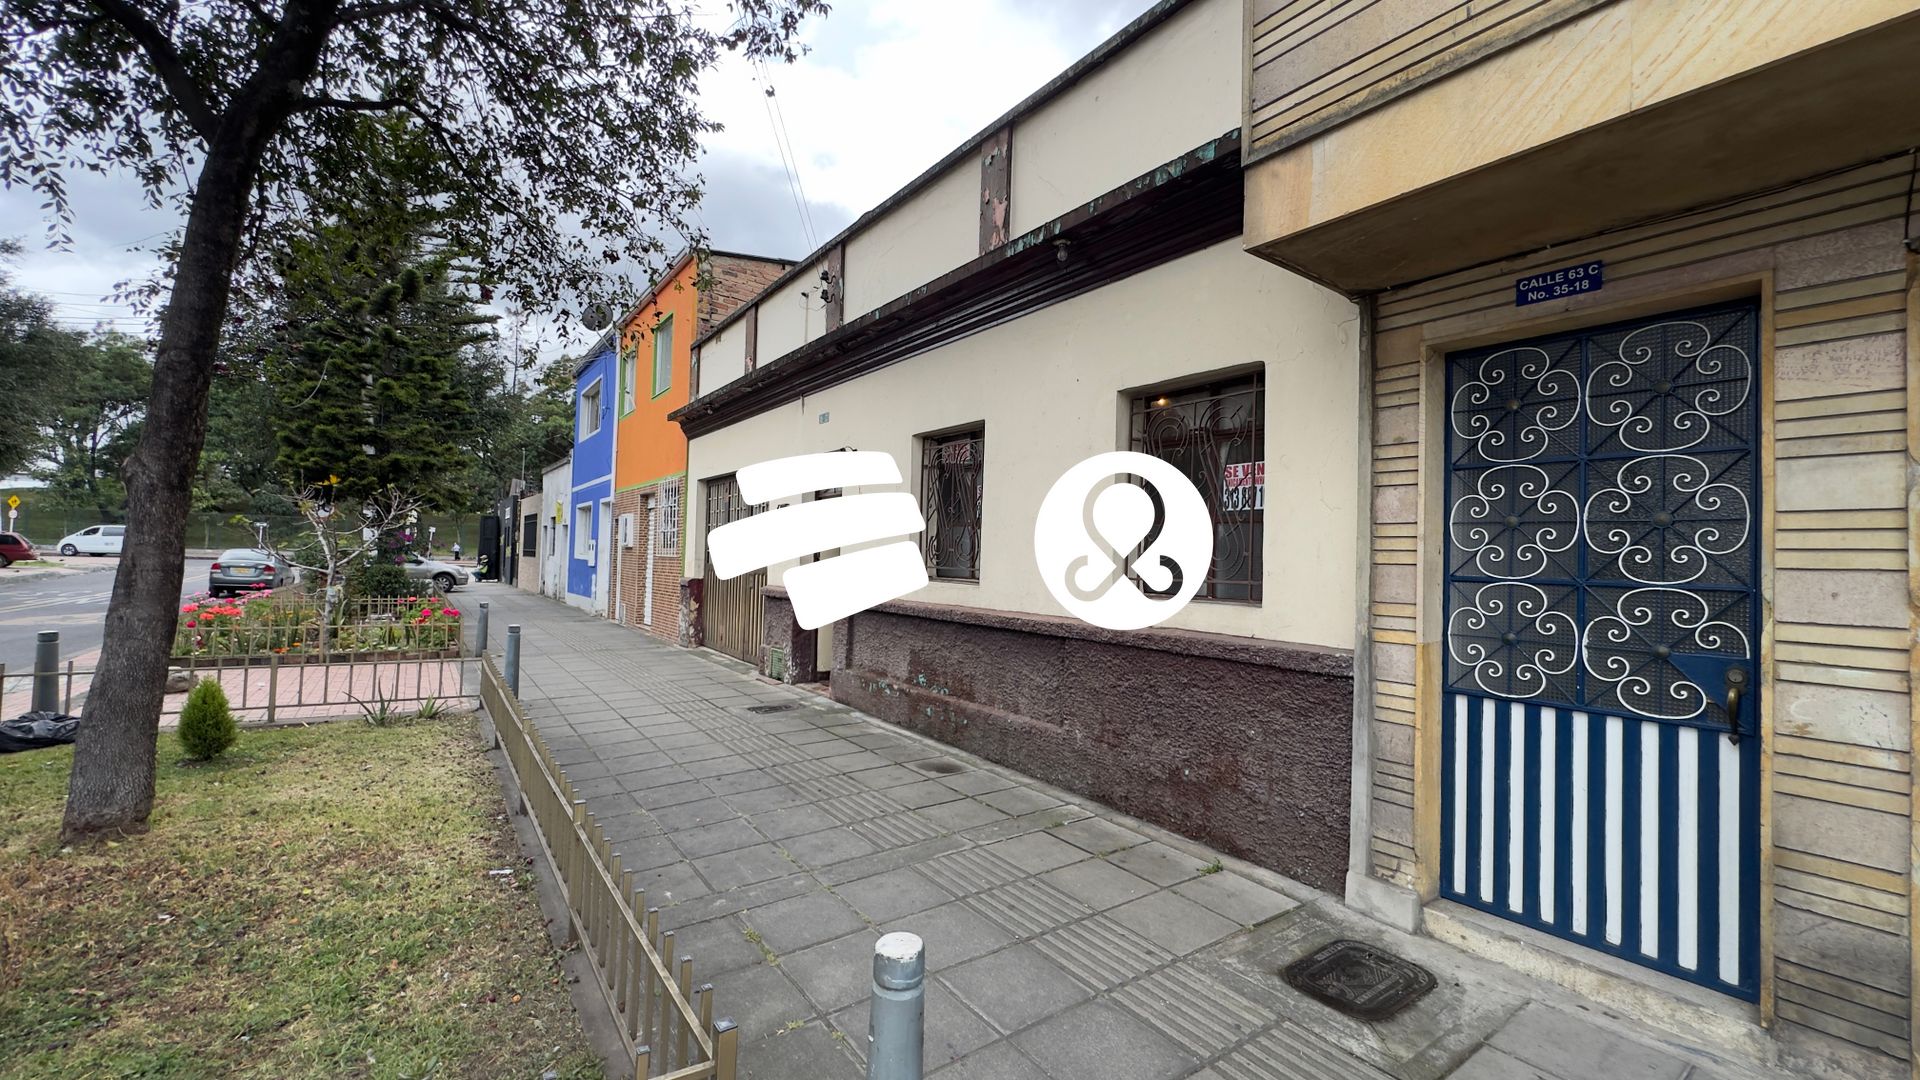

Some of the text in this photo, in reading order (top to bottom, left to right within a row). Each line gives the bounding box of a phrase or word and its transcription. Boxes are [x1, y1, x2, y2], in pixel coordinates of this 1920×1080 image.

[1519, 264, 1599, 291] CALLE 63 C
[1528, 279, 1589, 301] No. 35-18
[1225, 465, 1239, 478] SE
